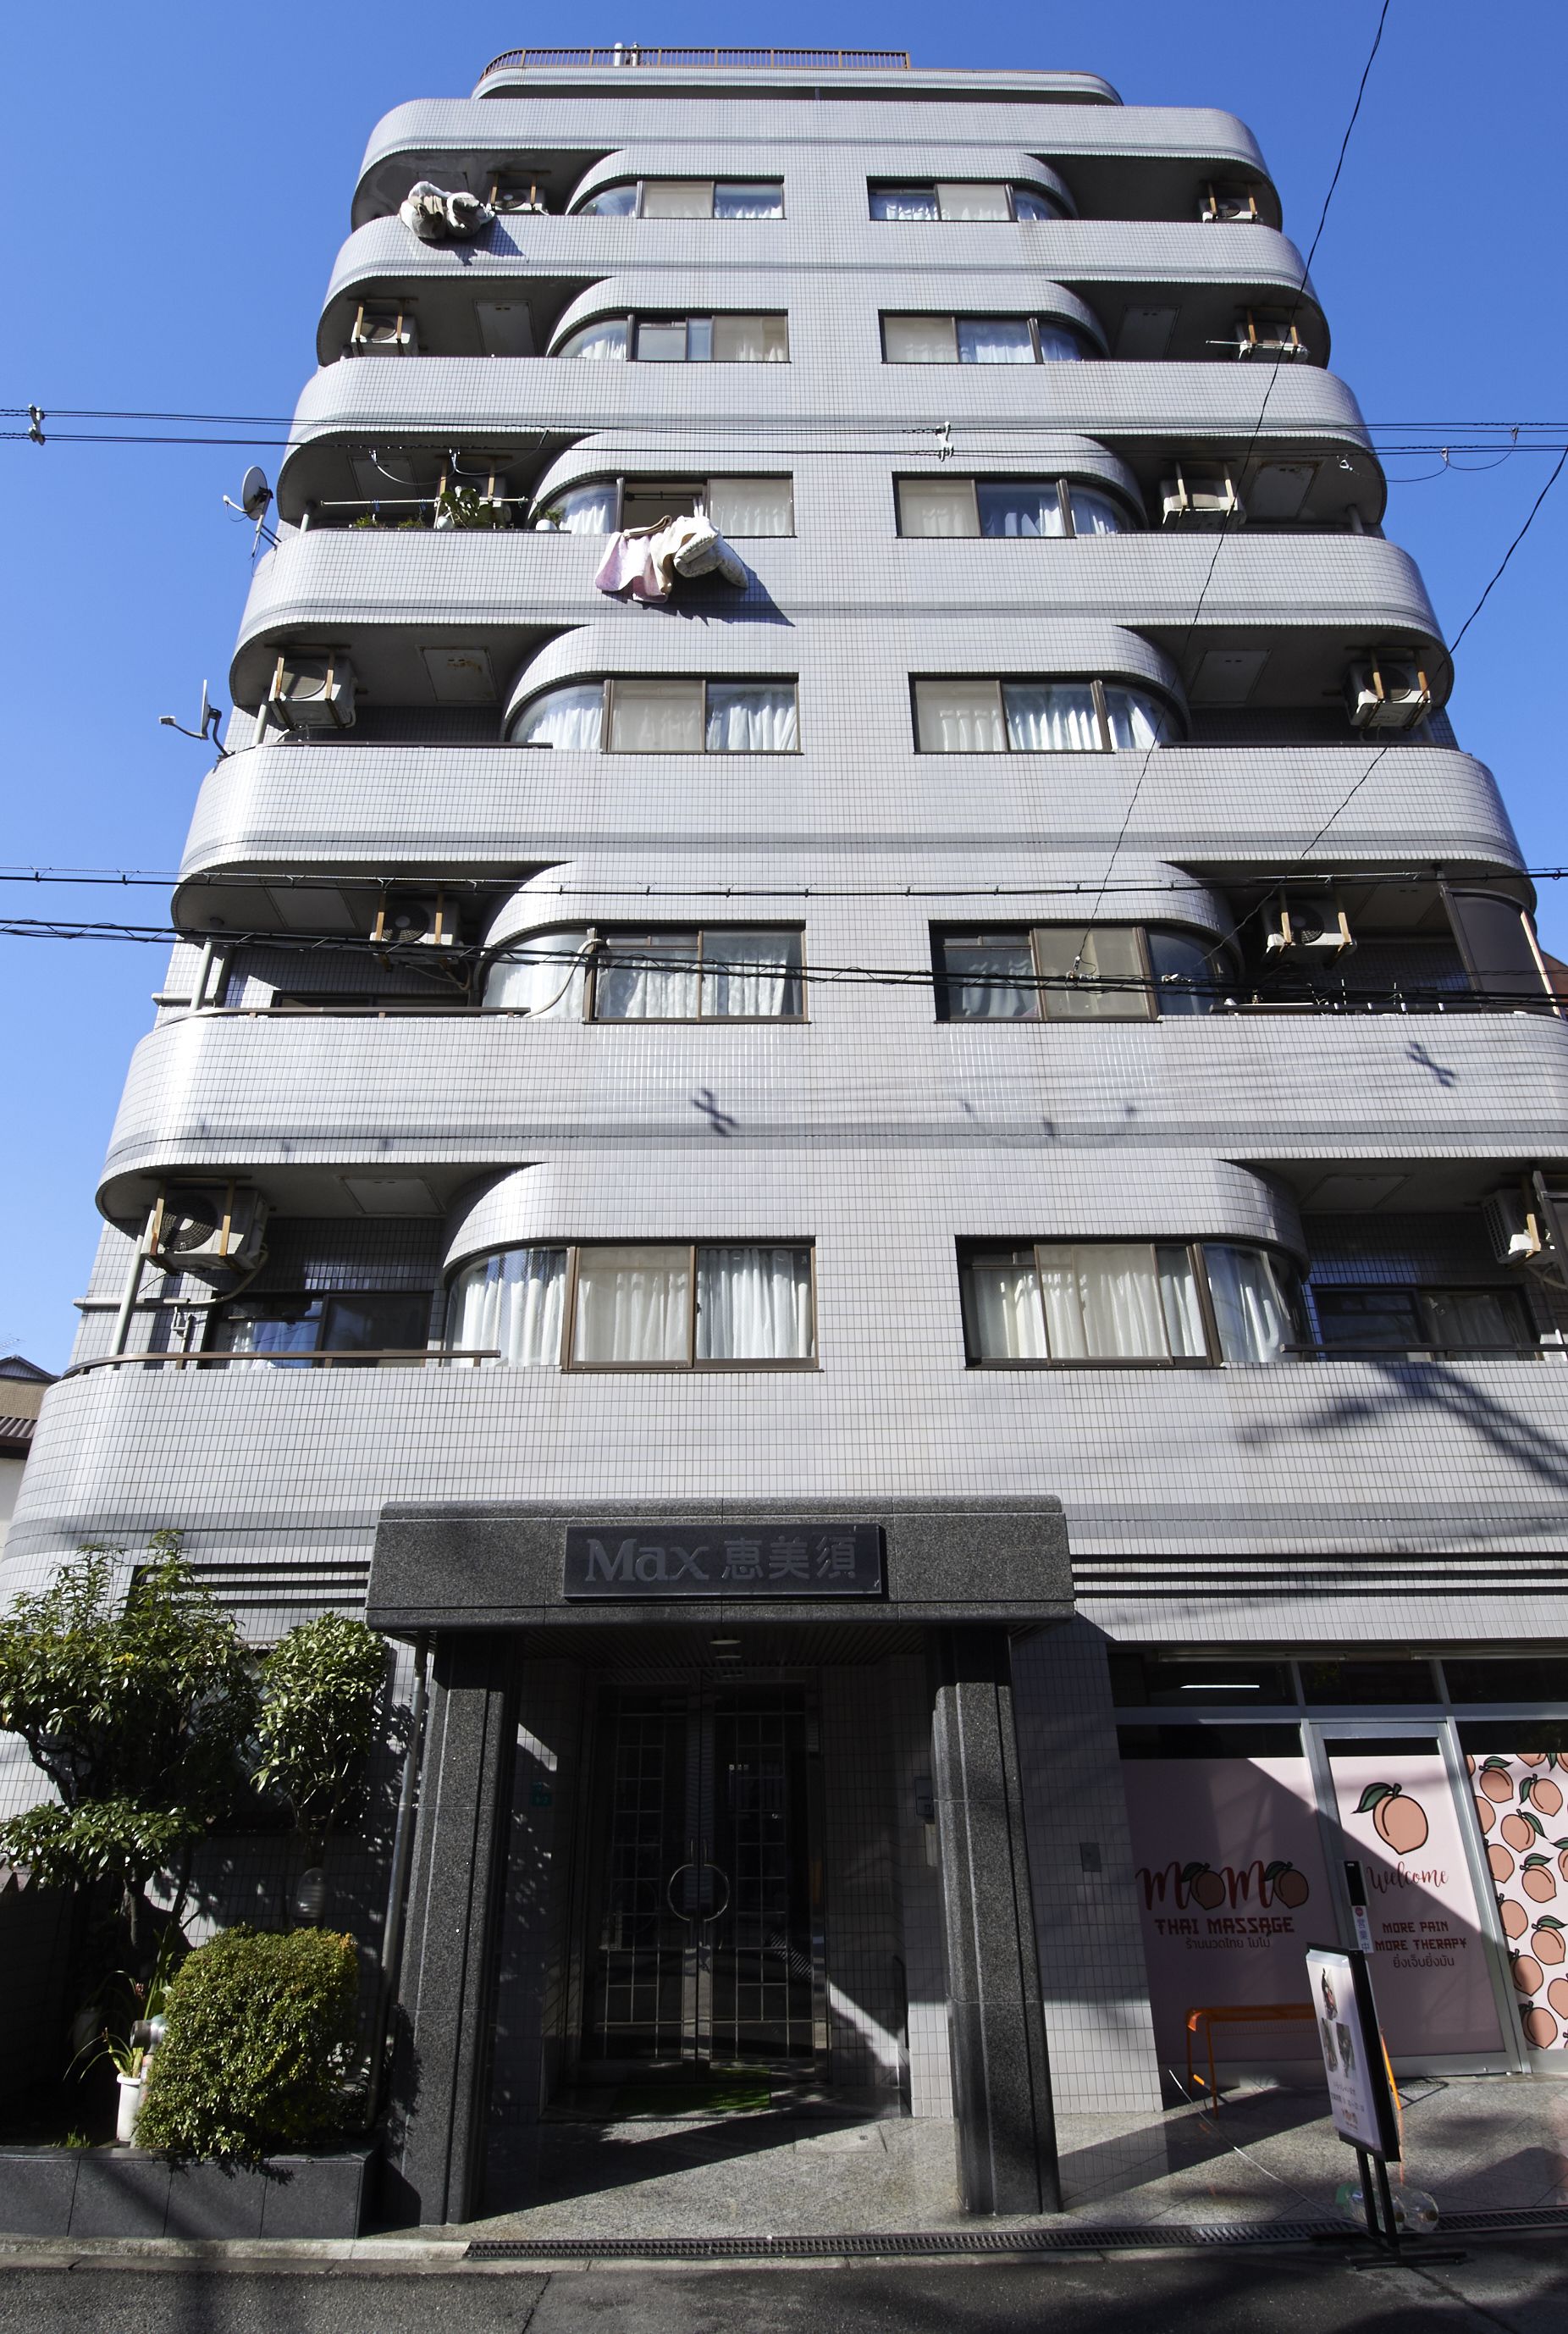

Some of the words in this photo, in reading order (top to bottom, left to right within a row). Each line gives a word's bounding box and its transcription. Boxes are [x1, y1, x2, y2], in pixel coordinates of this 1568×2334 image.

[584, 1538, 709, 1582] Max
[721, 1535, 856, 1581] 恵美須
[1368, 1861, 1449, 1894] Welcome
[1155, 1918, 1199, 1935] THAI
[1206, 1916, 1295, 1934] MASSAGE
[1382, 1922, 1416, 1933] MORE
[1420, 1921, 1449, 1932] PAIN
[1375, 1940, 1408, 1951] MORE
[1413, 1938, 1466, 1950] THERAPY
